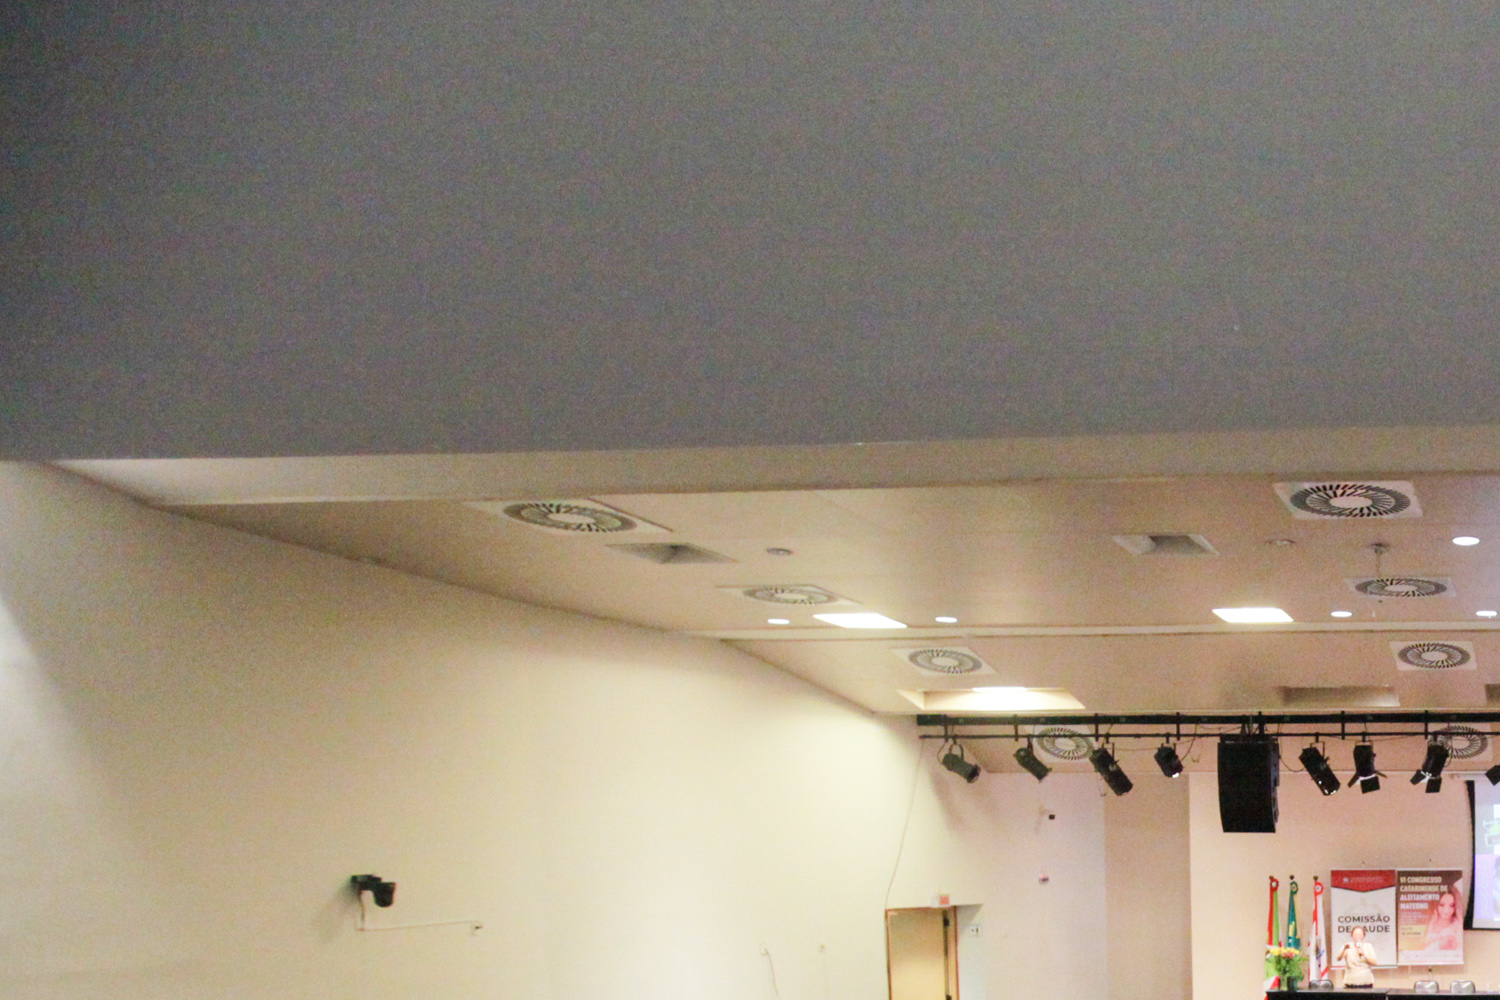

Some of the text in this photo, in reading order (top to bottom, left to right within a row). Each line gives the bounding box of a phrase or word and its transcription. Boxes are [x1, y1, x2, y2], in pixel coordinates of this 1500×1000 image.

[1399, 893, 1440, 901] ALEITAMENTO
[1399, 902, 1428, 910] MATERNO
[1337, 914, 1391, 924] COMISSÃO
[1337, 925, 1351, 934] DE
